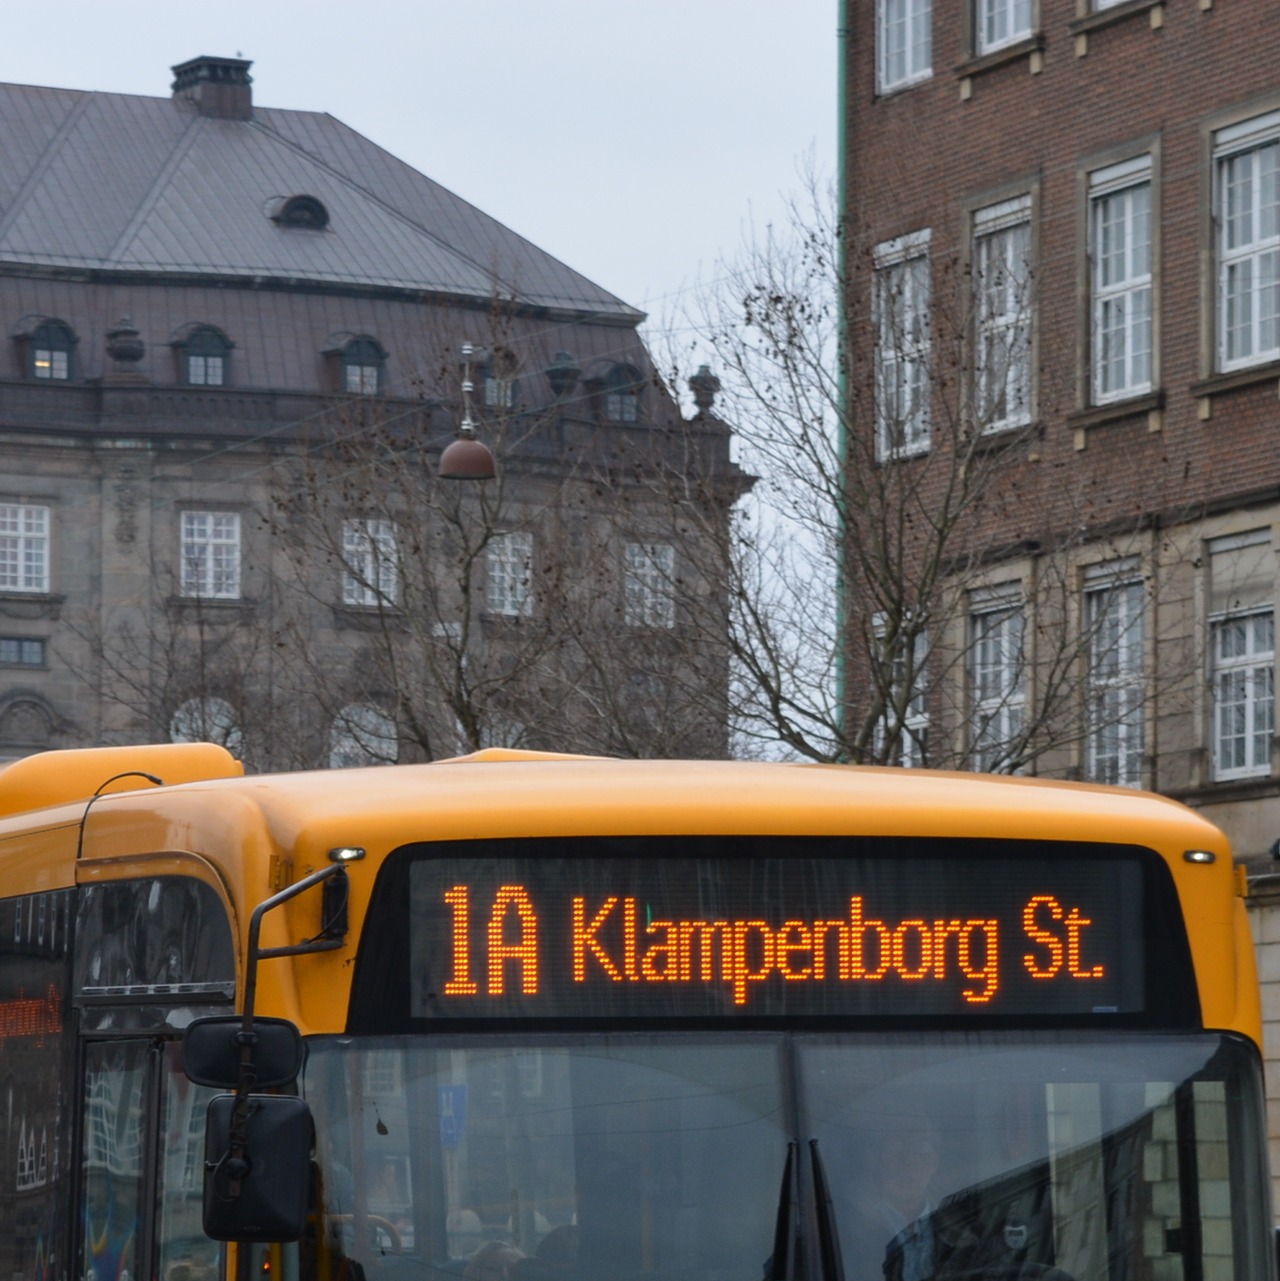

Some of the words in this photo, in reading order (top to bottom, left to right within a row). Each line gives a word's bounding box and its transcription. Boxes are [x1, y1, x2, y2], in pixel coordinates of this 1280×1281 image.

[443, 885, 539, 995] 1A
[573, 896, 999, 1004] Klampenborg
[1023, 896, 1104, 978] St.
